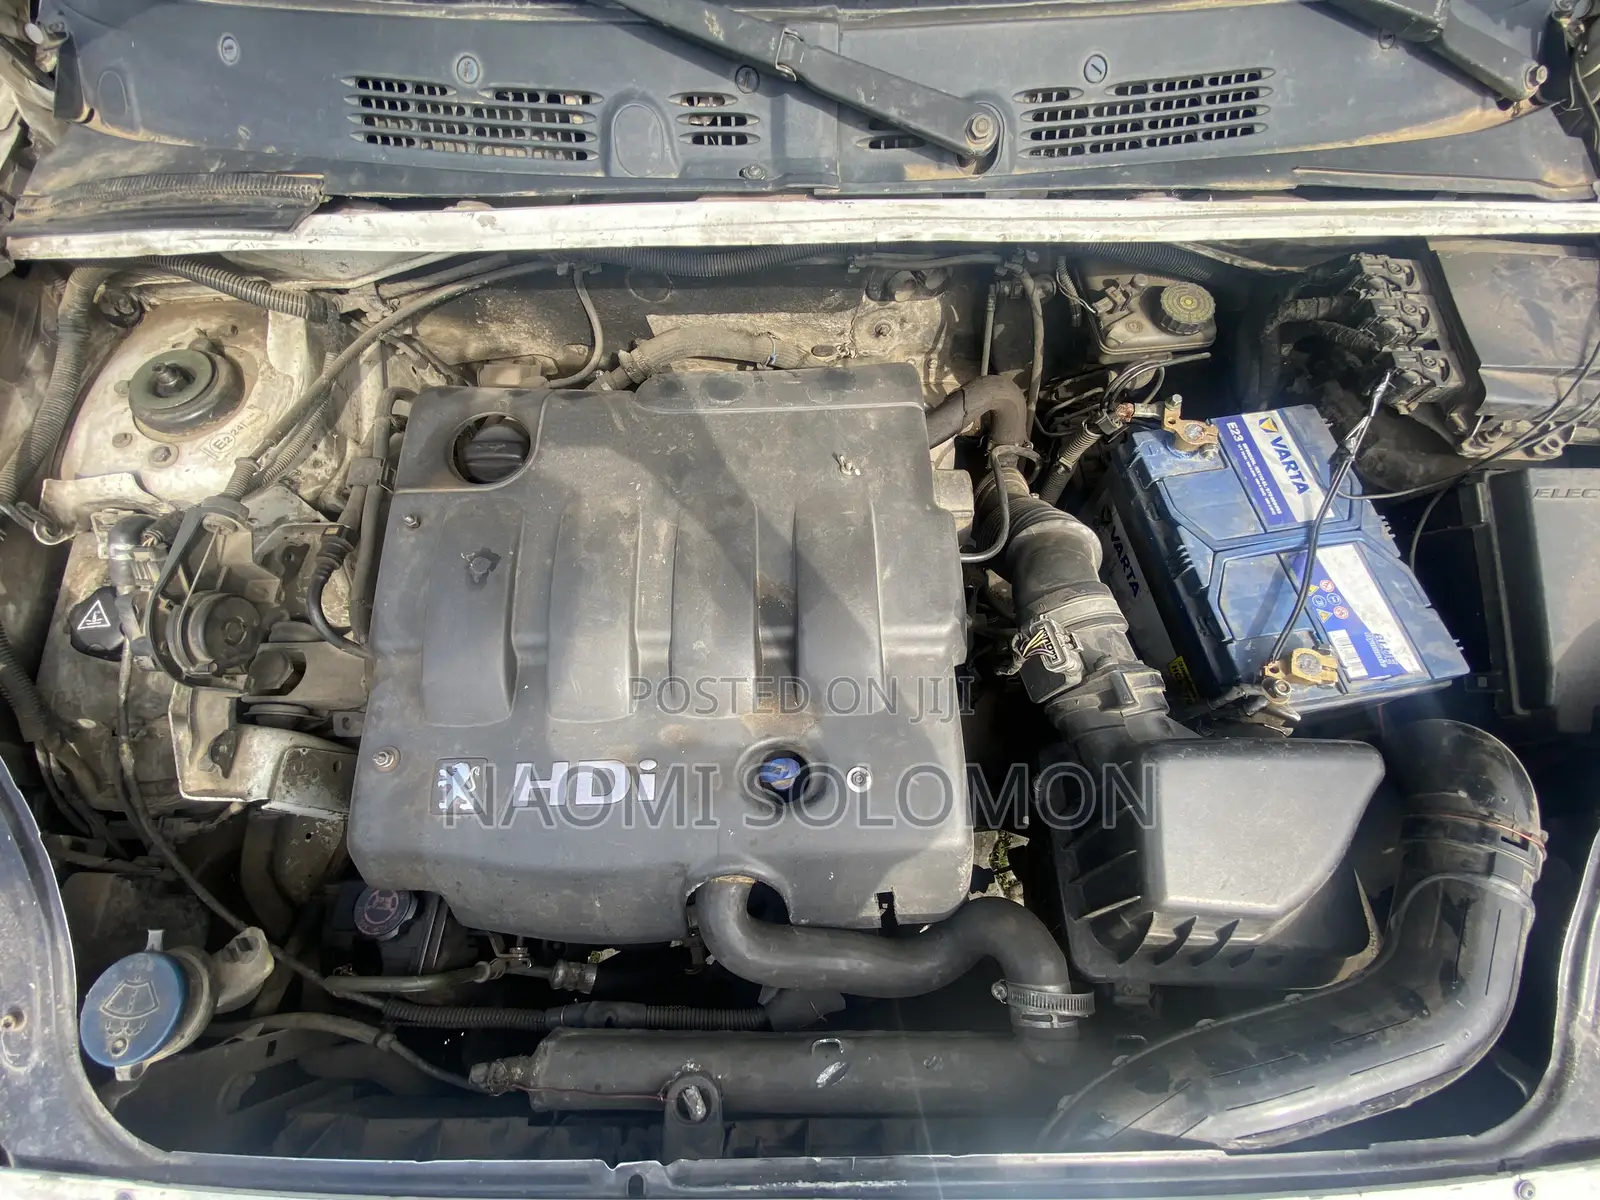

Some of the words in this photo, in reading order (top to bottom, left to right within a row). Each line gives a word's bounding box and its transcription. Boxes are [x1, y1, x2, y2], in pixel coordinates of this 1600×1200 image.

[1226, 421, 1244, 442] E23
[1270, 435, 1310, 495] VARTA
[1533, 488, 1600, 499] ELEC
[1110, 524, 1140, 598] VARTA
[512, 758, 659, 808] HDi
